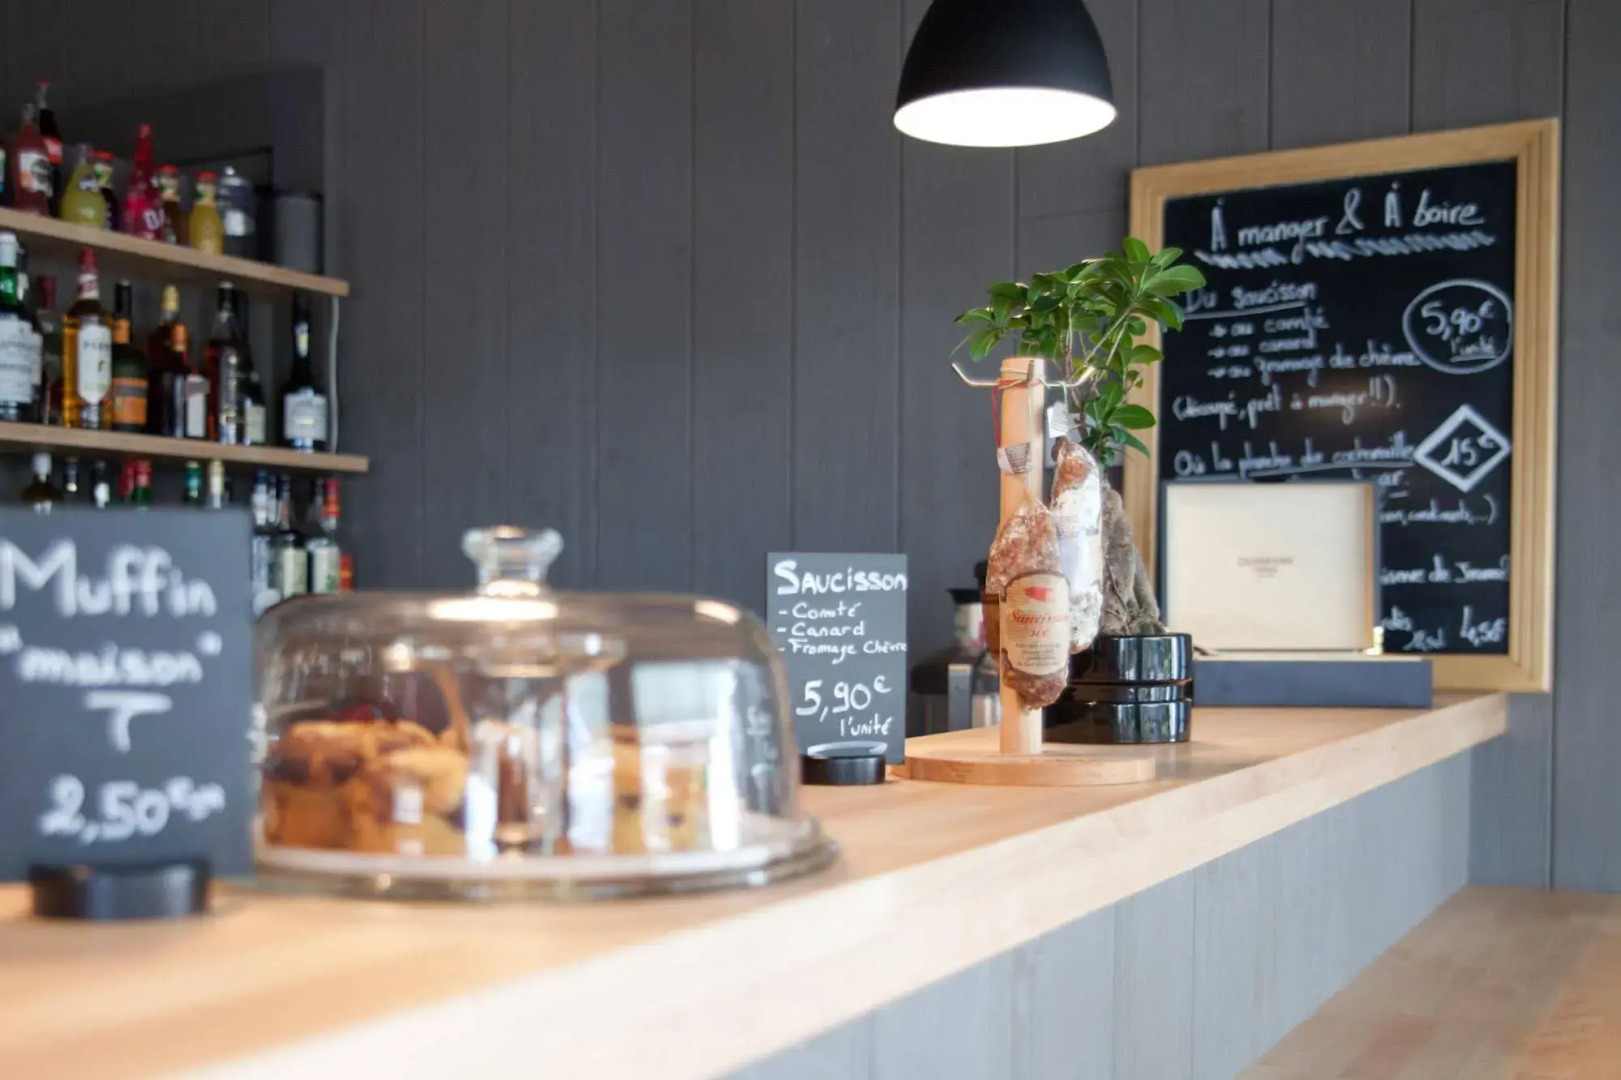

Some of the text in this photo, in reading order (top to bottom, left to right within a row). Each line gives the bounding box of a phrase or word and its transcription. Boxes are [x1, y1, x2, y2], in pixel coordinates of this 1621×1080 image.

[1238, 215, 1329, 264] manger
[1335, 187, 1364, 234] &
[1413, 189, 1485, 226] boire
[1231, 280, 1316, 309] Saucisson
[1421, 300, 1495, 340] 5,90€
[1211, 441, 1234, 471] la
[1441, 434, 1496, 466] 15€
[0, 539, 218, 617] Muffin
[796, 675, 892, 722] 5,90€
[840, 713, 893, 736] l'unité
